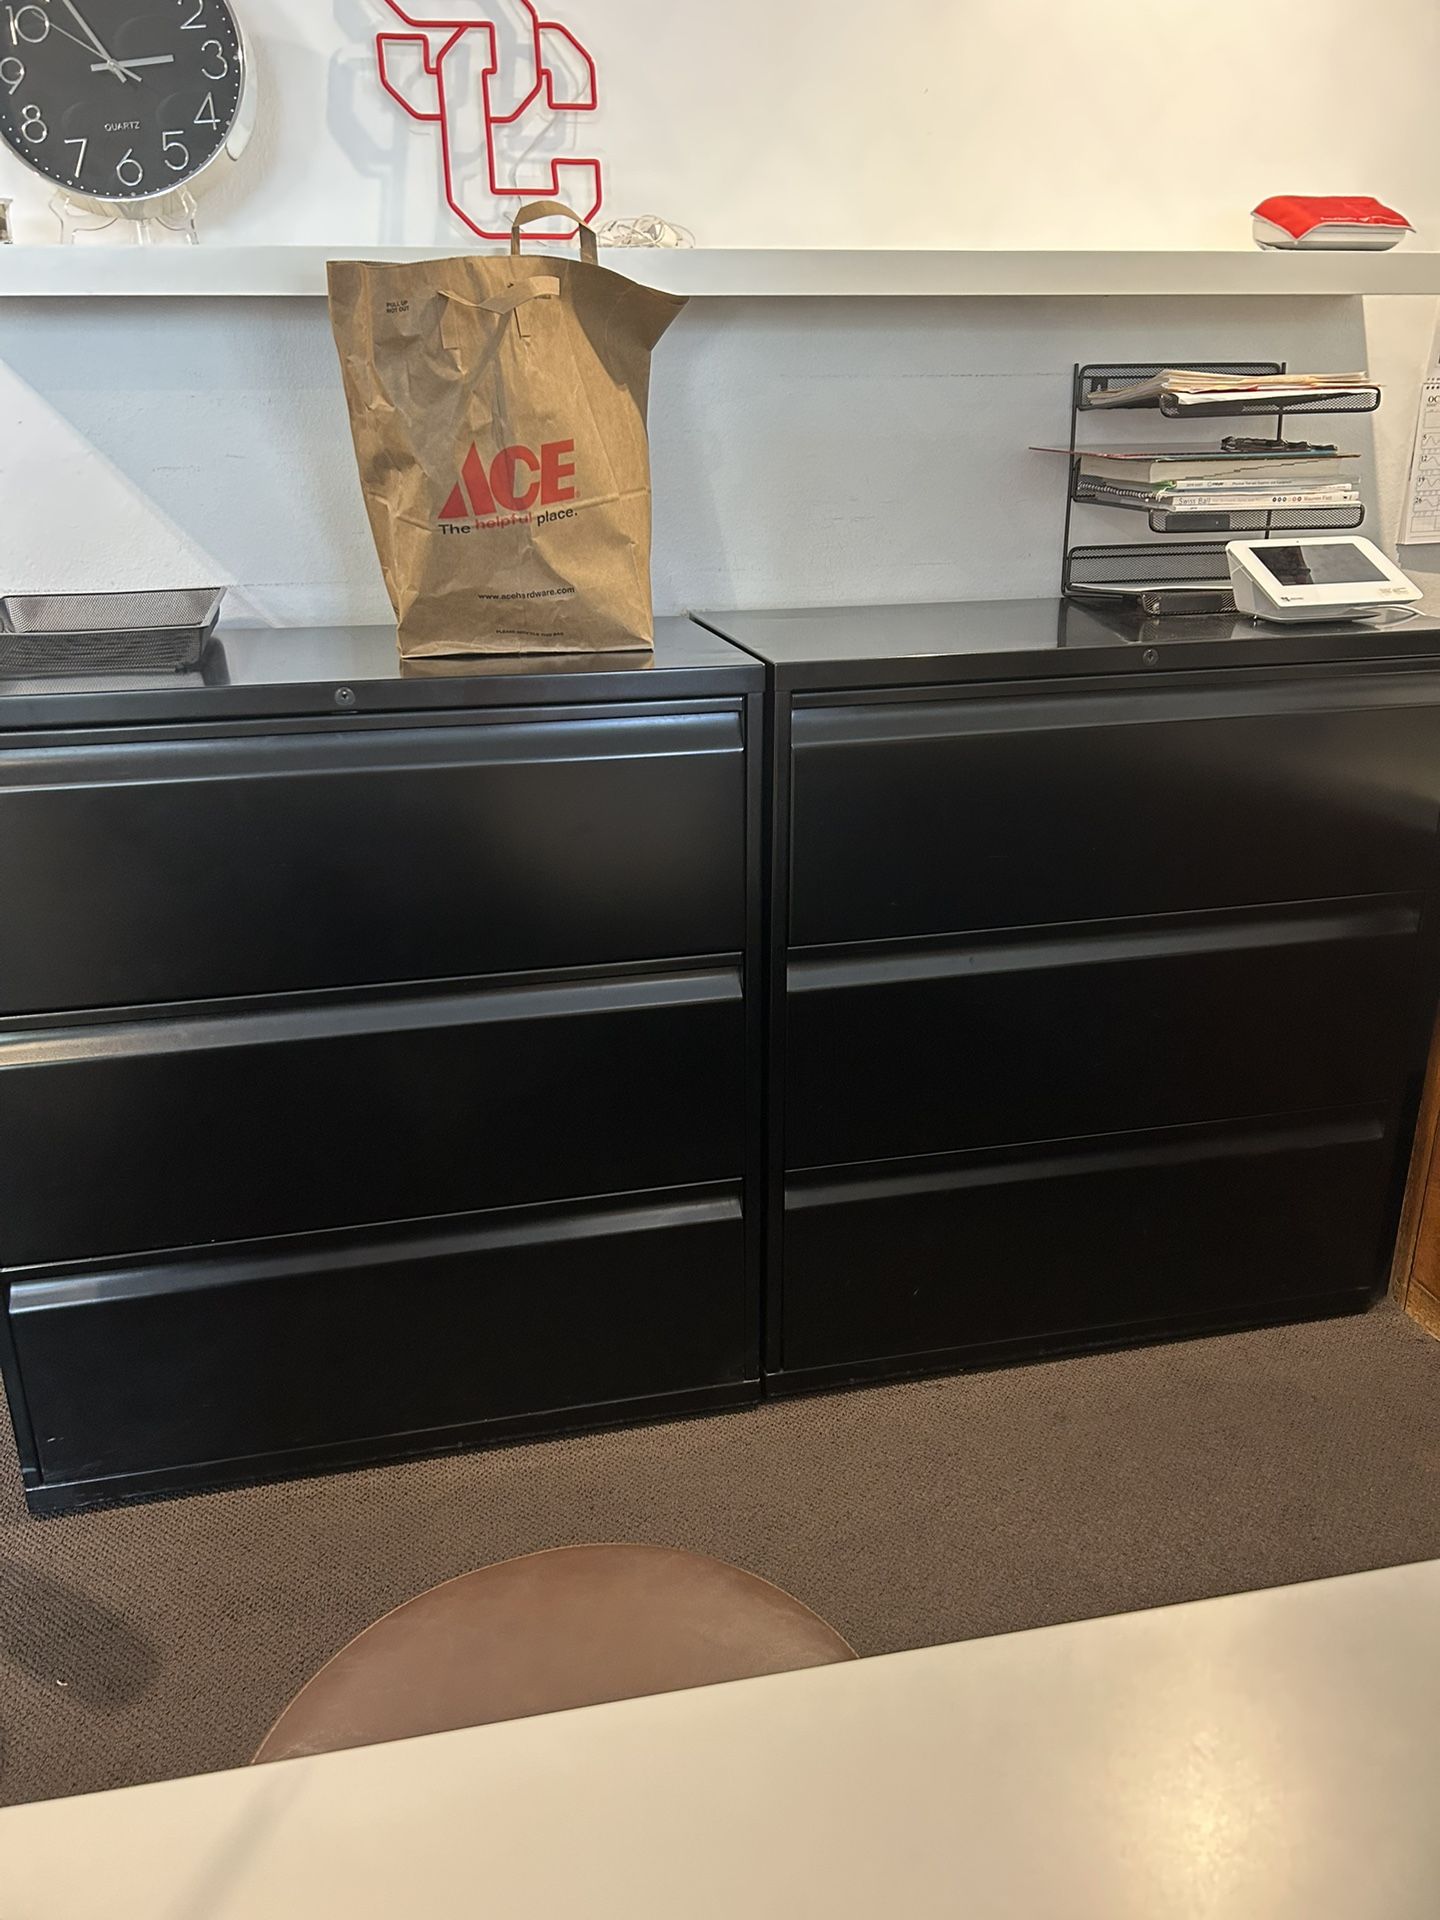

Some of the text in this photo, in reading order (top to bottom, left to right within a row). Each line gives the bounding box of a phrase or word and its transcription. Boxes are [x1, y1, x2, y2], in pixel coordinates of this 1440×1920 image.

[5, 4, 50, 45] 10
[177, 0, 207, 29] 2
[0, 56, 25, 95] 9
[200, 39, 228, 80] 3
[21, 104, 48, 143] 8
[104, 120, 141, 132] QUARTZ
[193, 91, 221, 130] 4
[63, 137, 88, 178] 7
[115, 148, 144, 187] 6
[161, 130, 190, 171] 5
[437, 438, 576, 520] ACE
[438, 508, 578, 535] The helpful place.
[478, 587, 575, 600] www.acehardware.com
